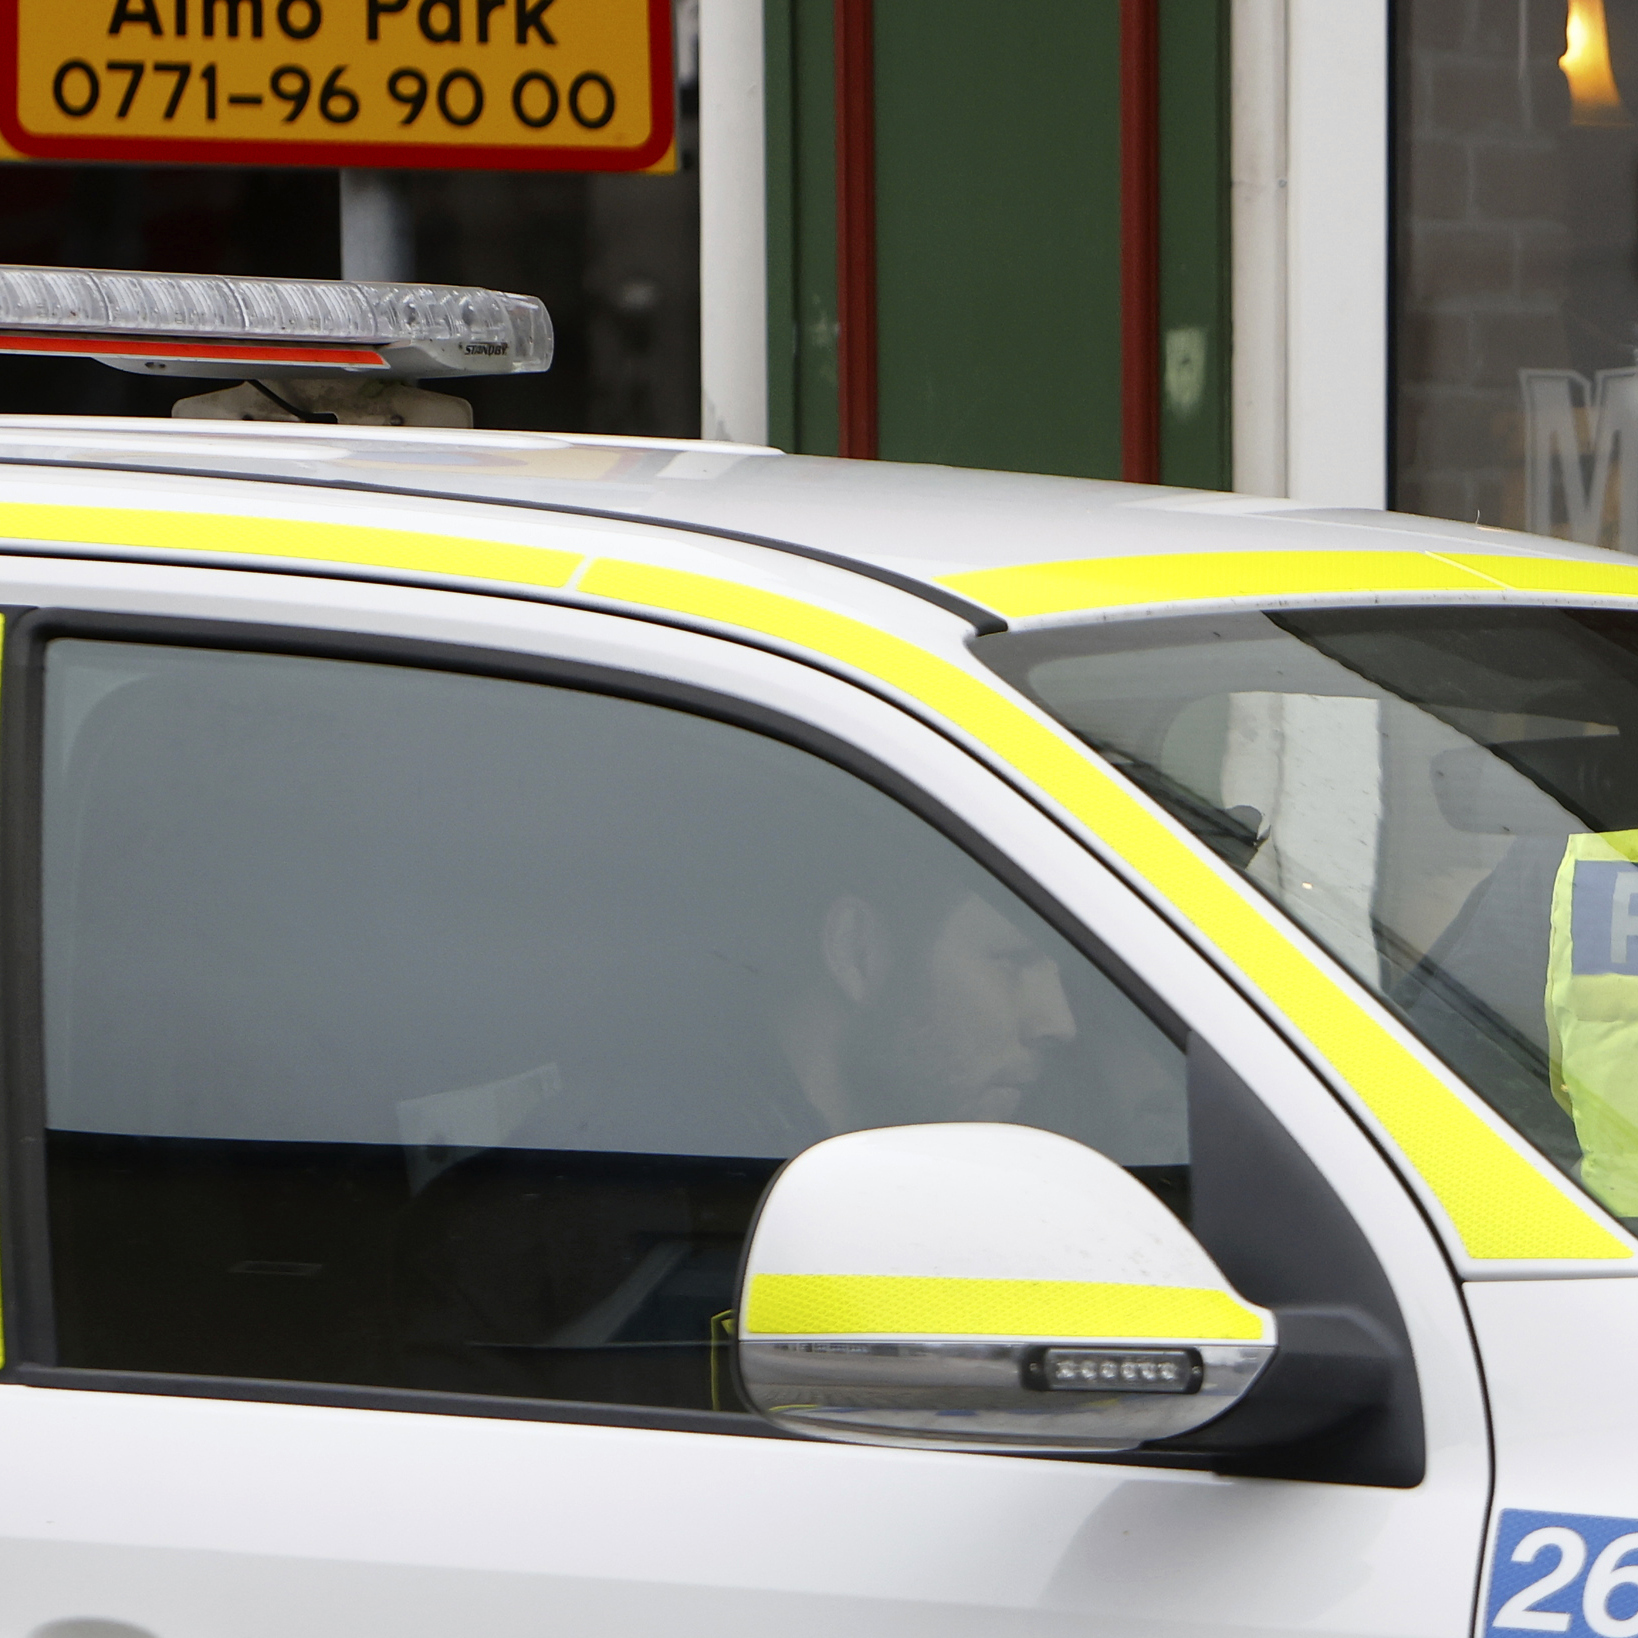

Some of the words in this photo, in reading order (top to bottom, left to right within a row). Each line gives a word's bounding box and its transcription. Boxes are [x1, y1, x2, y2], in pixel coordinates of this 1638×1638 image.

[367, 0, 557, 45] Park
[52, 58, 360, 125] 0771-96
[387, 66, 485, 127] 90
[511, 69, 616, 129] 00
